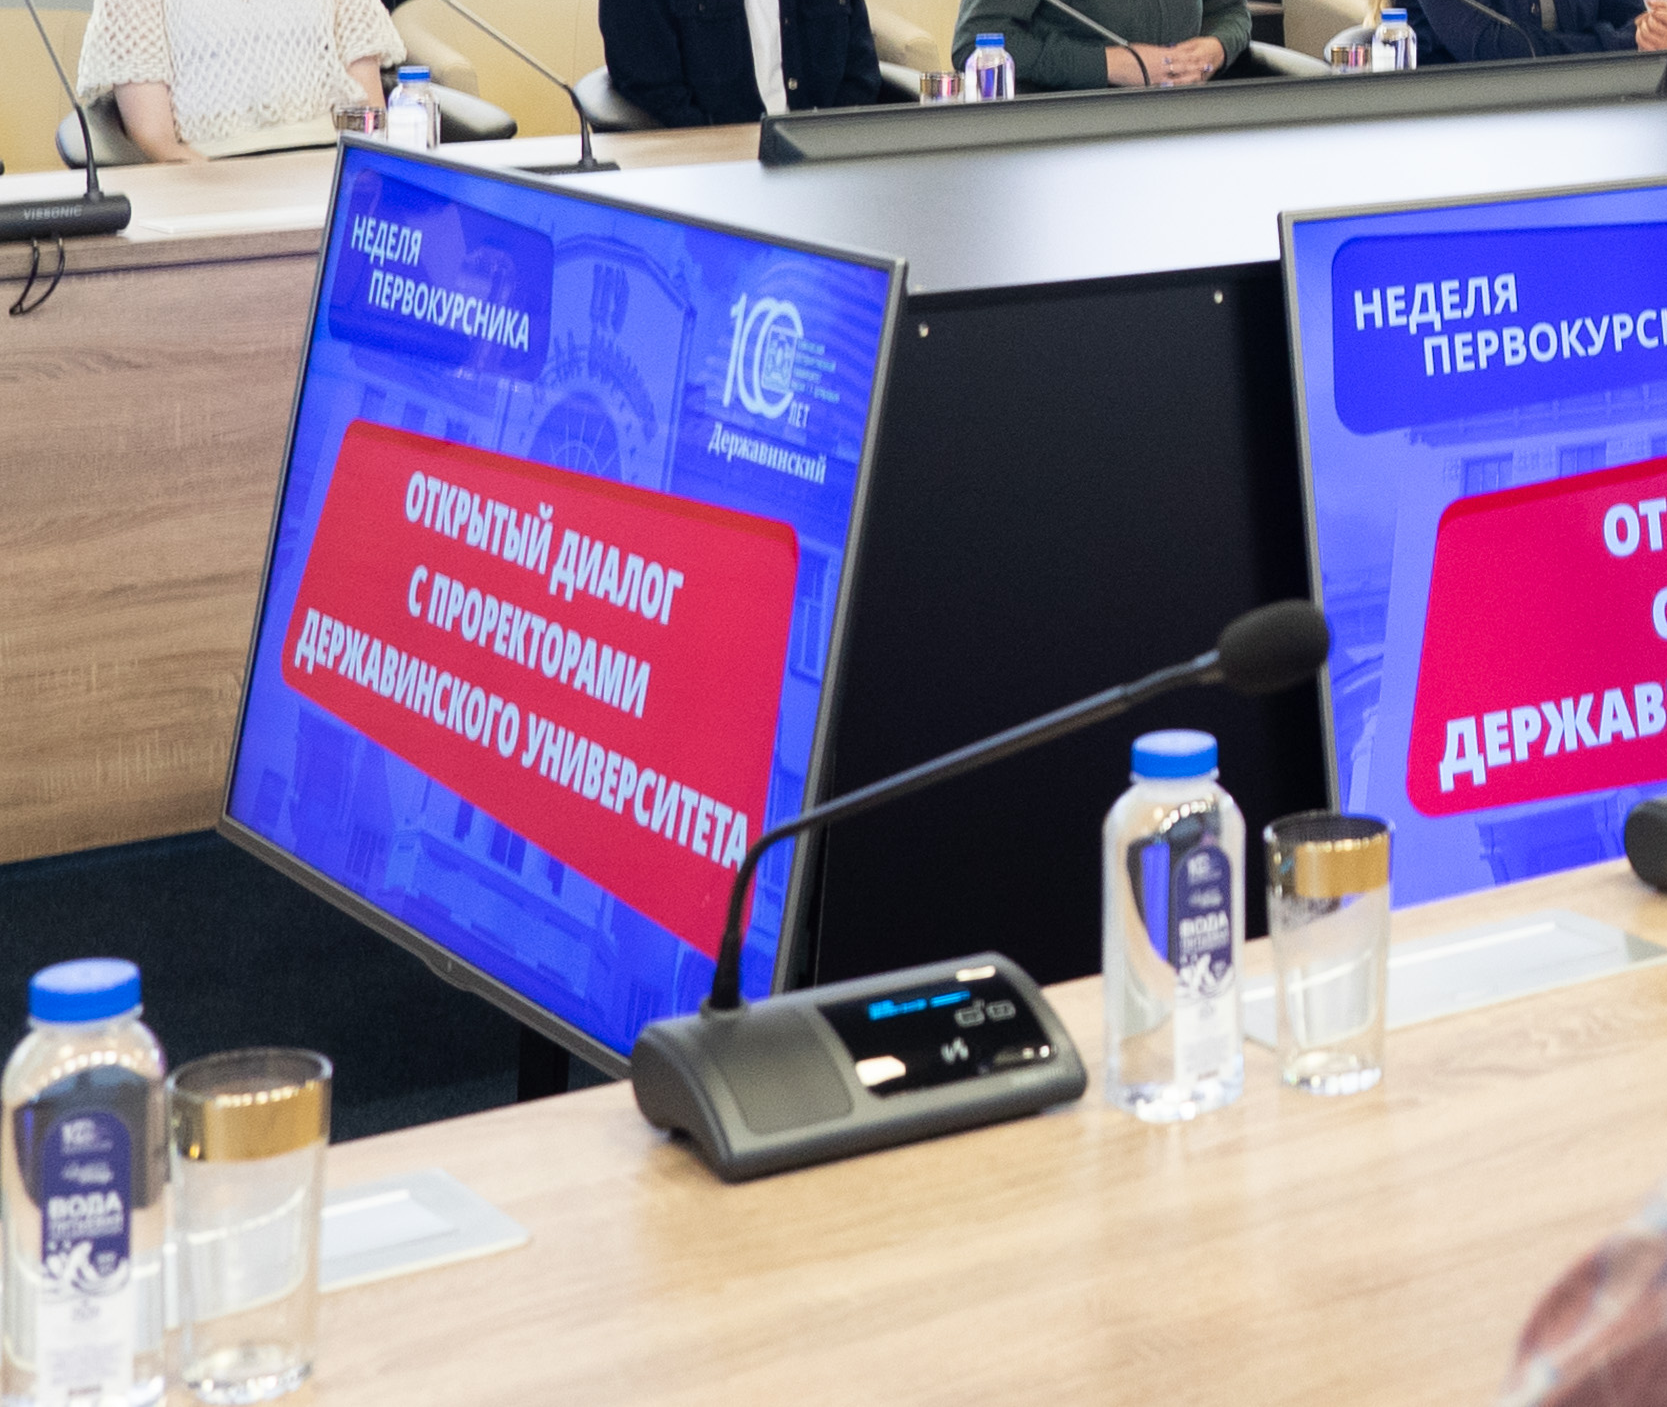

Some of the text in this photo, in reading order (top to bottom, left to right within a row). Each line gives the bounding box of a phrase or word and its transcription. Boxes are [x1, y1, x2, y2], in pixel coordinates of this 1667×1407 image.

[350, 214, 424, 268] НЕДЕЛЯ
[367, 268, 531, 353] ПЕРВОКУРСНИКА
[1353, 273, 1519, 335] НЕДЕЛЯ
[709, 421, 827, 484] Державинский
[404, 470, 685, 626] ОТКРЫТЫЙ ДИАЛОГ
[407, 564, 652, 719] С ПРОРЕКТОРАМИ
[293, 606, 749, 873] ДЕРЖАВИНСКОГО УНИВЕРСИТЕТА
